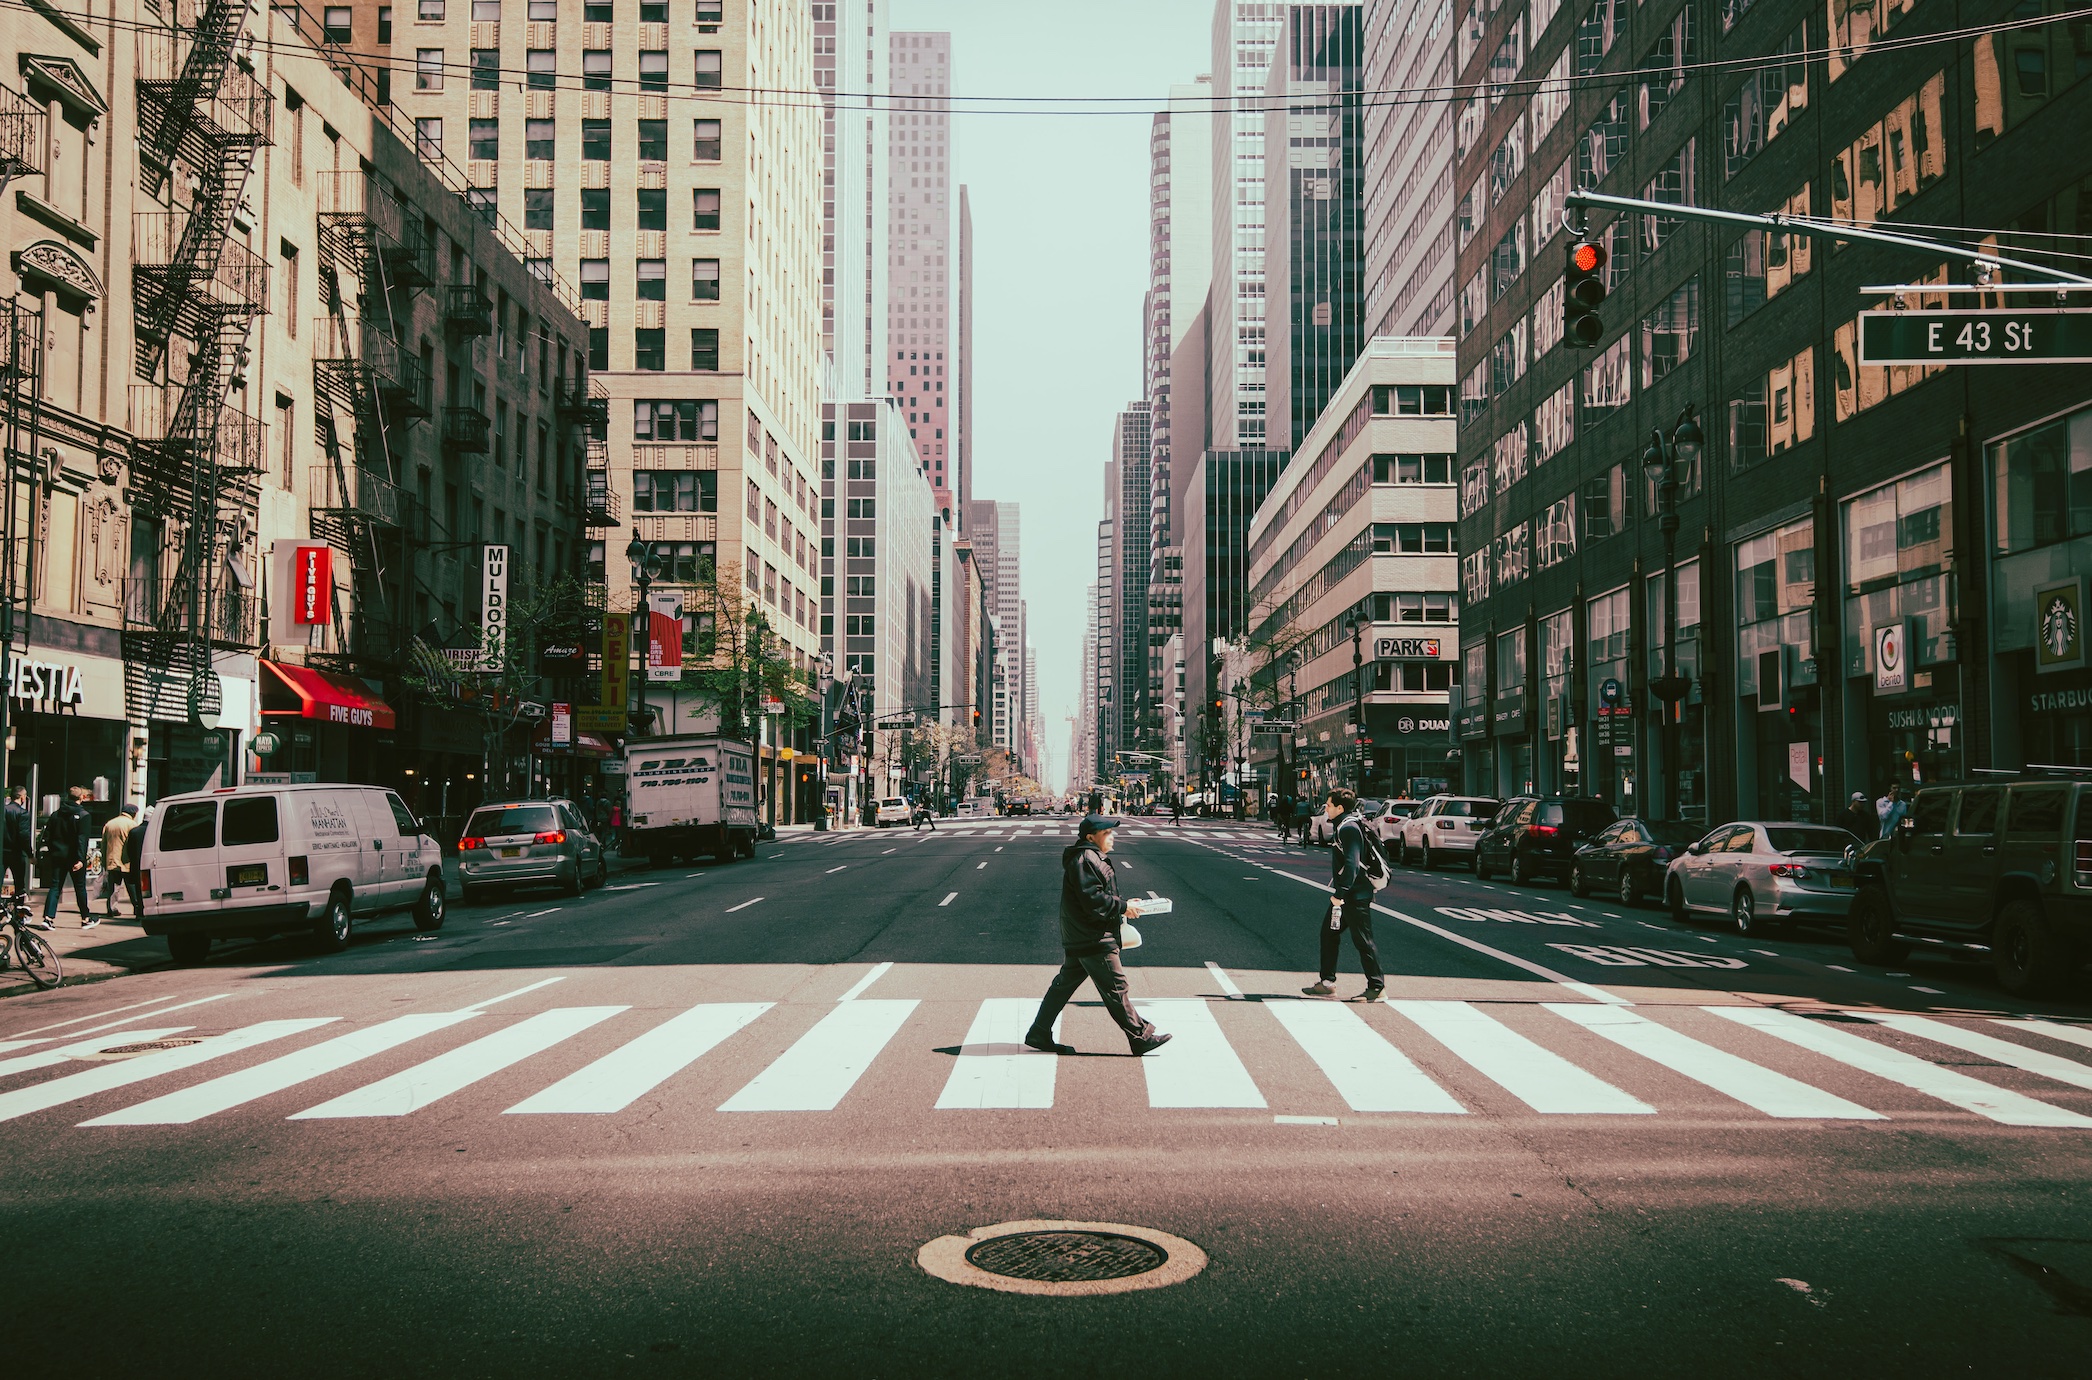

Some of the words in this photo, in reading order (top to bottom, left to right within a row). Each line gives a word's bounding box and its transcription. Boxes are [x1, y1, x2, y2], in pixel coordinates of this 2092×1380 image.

[1928, 322, 1944, 352] E
[1955, 321, 1991, 352] 43
[2004, 321, 2033, 352] St
[307, 551, 317, 585] FIVE
[306, 586, 316, 619] GUYS
[448, 650, 480, 660] IRISH
[543, 644, 578, 657] Amaze
[1380, 640, 1425, 655] PARK
[607, 617, 625, 706] DELI
[1880, 674, 1901, 687] bento
[329, 704, 348, 723] FIVE
[350, 707, 373, 727] GUYS
[1888, 711, 1915, 728] SUSHI
[1917, 708, 1924, 725] &
[1418, 719, 1450, 731] DUAN
[255, 736, 273, 746] NAYA
[637, 769, 687, 777] PLUMBING
[311, 818, 348, 829] MANHATTAN
[1433, 906, 1602, 928] ONLY
[1544, 942, 1750, 969] BUS
